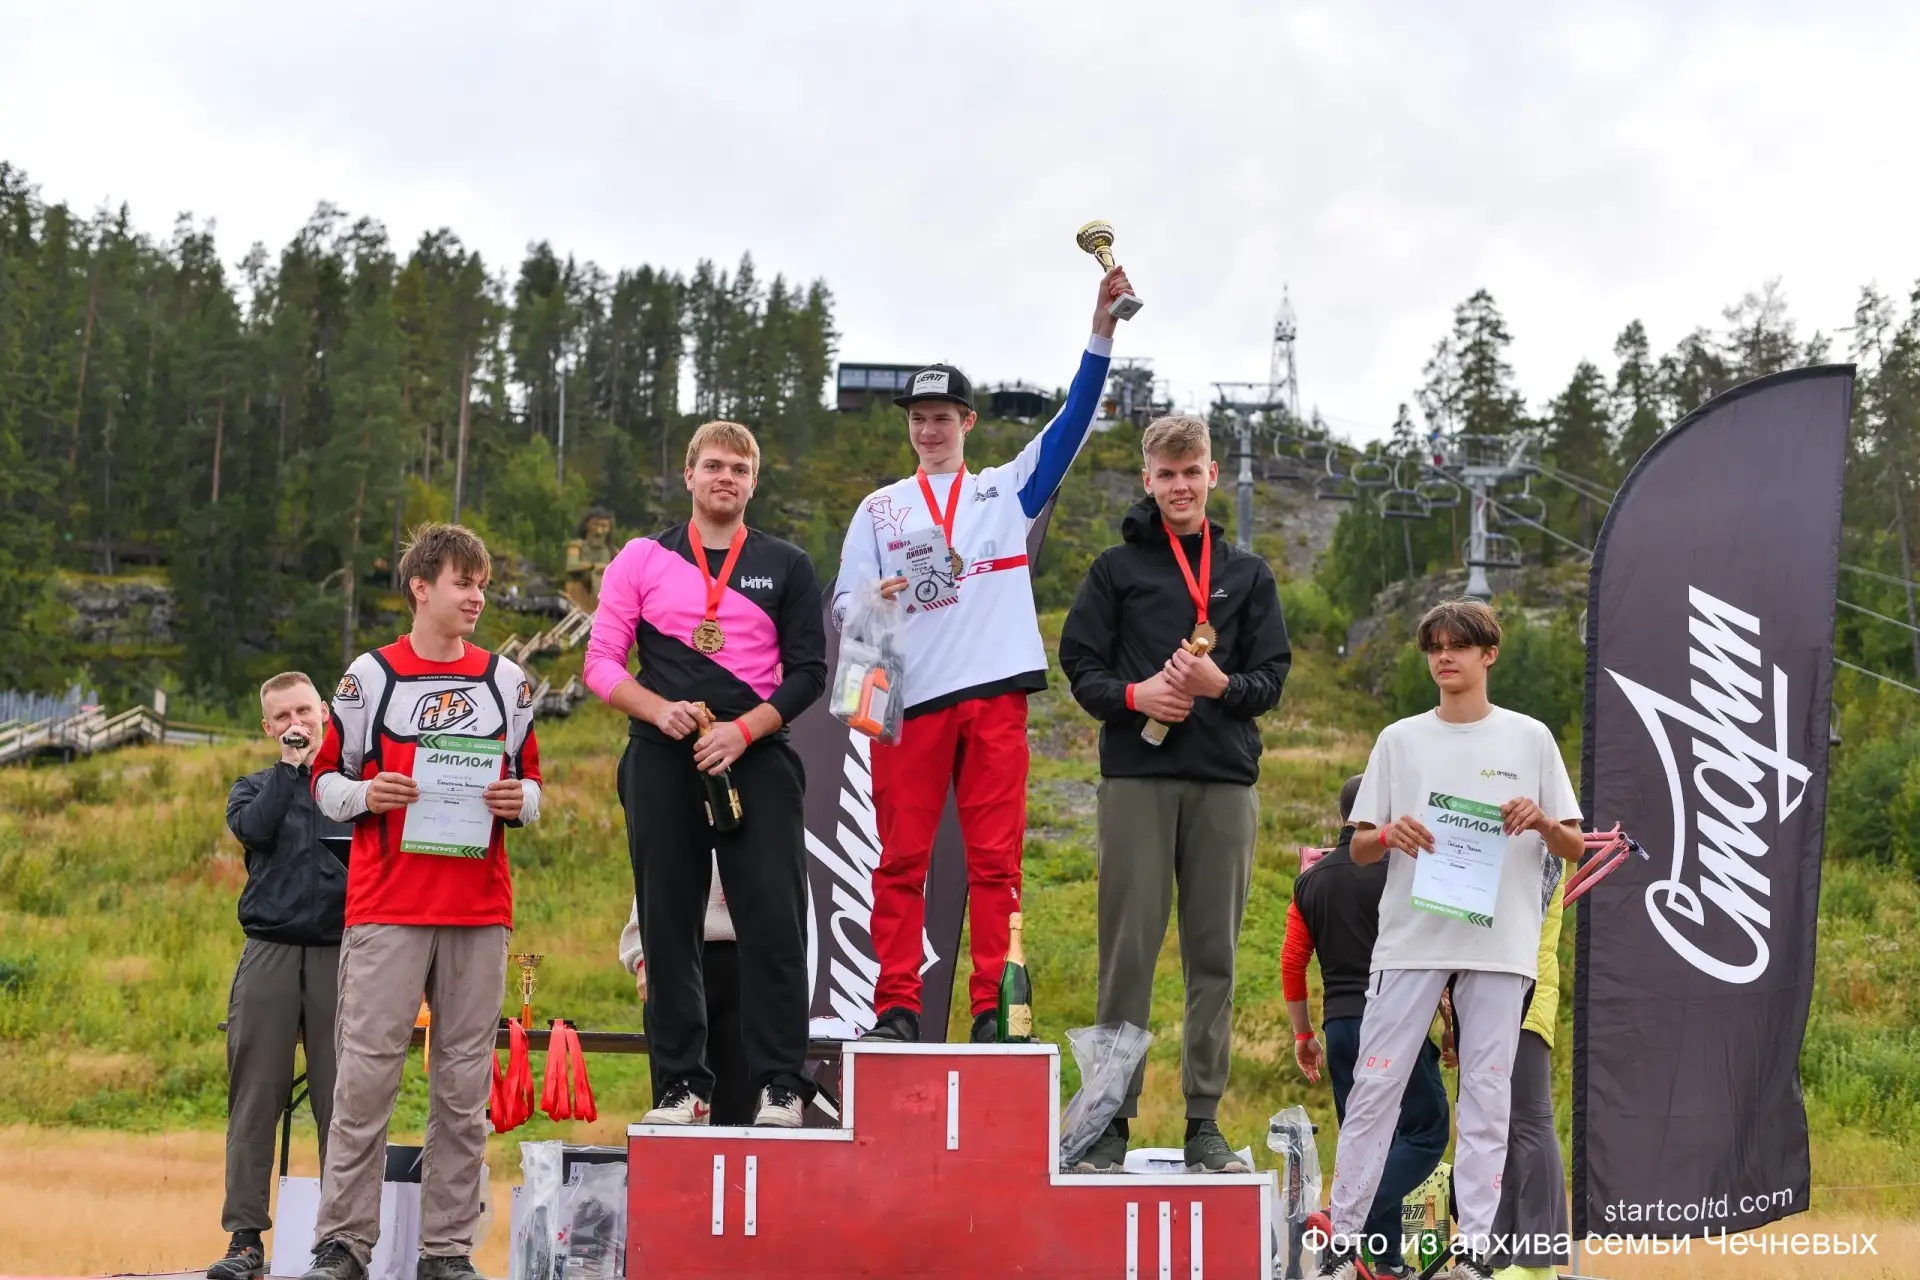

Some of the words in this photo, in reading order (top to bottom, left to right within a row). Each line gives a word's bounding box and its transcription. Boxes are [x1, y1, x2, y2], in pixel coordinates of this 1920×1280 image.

[916, 373, 945, 383] LEATT
[906, 546, 933, 560] ДИПЛОМ
[426, 753, 493, 768] ДИПЛОМ
[1437, 813, 1501, 836] ДИПЛОМ
[1402, 1203, 1426, 1220] ATT
[1604, 1187, 1793, 1223] startcoltd.com
